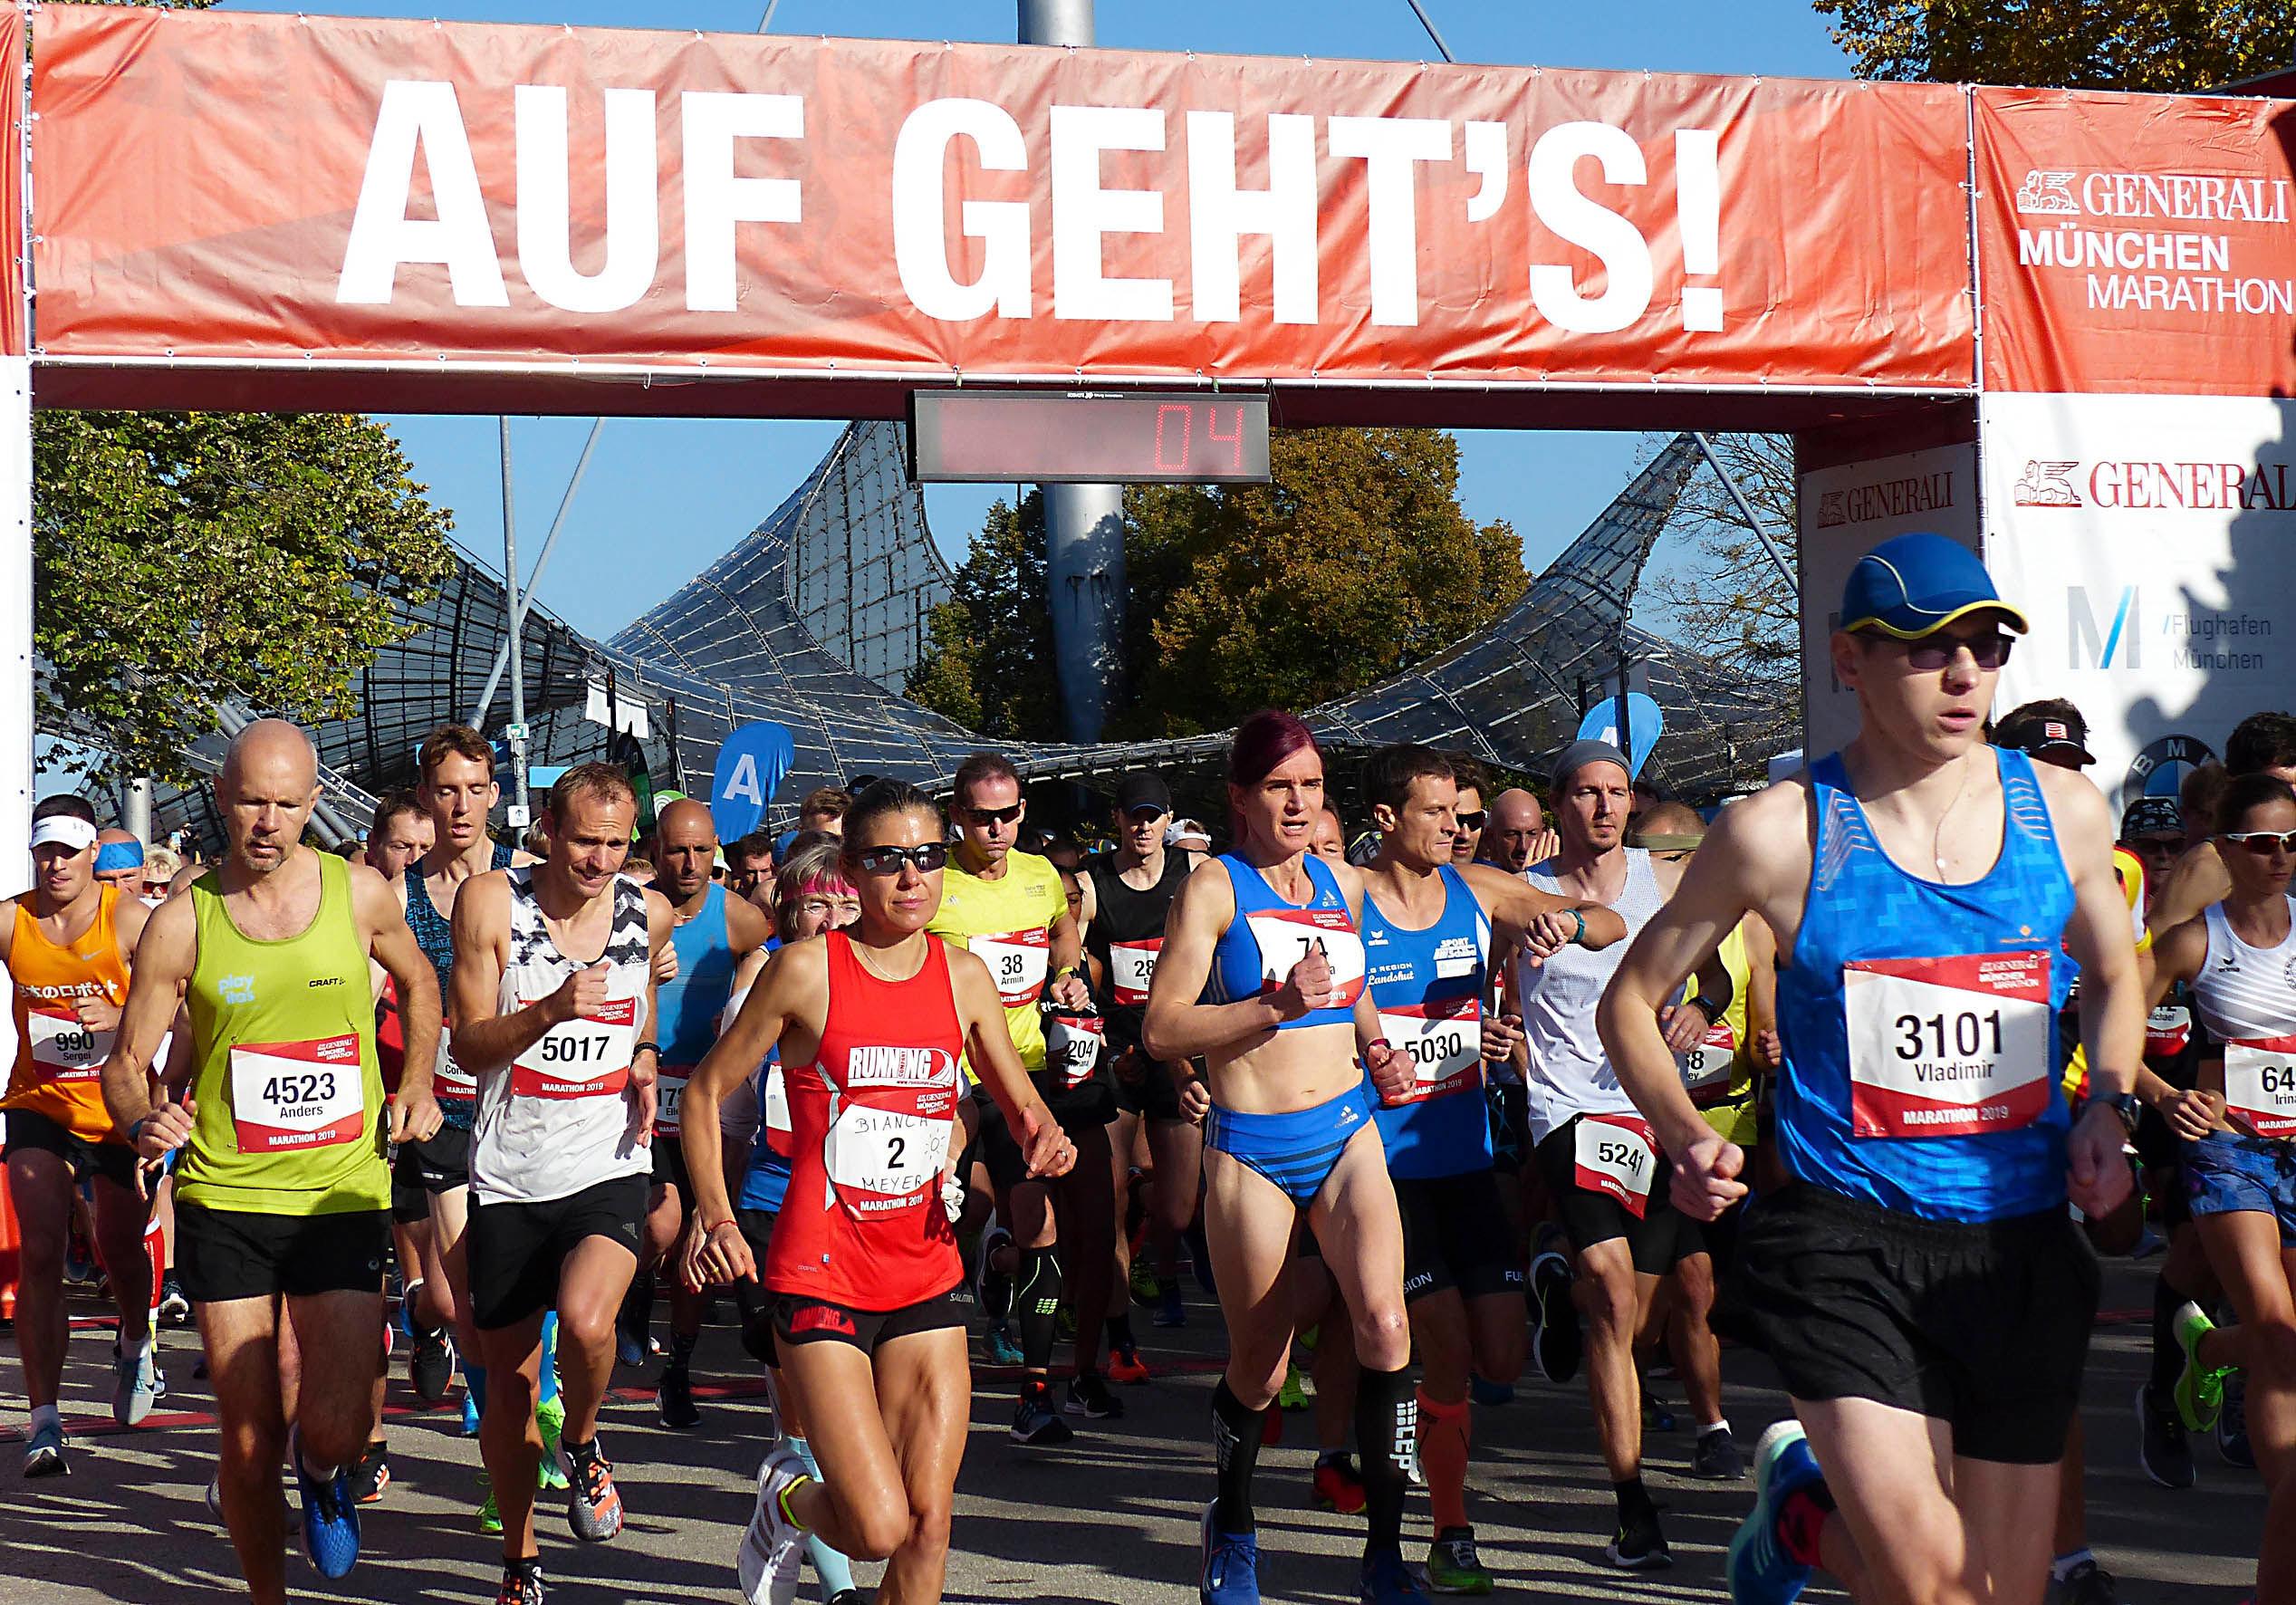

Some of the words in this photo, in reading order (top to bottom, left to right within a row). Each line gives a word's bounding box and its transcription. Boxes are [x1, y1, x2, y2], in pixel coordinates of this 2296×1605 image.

[335, 80, 804, 313] AUF
[892, 97, 1724, 334] GEHT'S!
[2083, 172, 2291, 224] GENERALI
[2019, 222, 2230, 272] MÜNCHEN
[2086, 274, 2293, 315] MARATHON
[1847, 471, 1955, 524] GENERALI
[2174, 649, 2263, 670] München
[722, 753, 763, 806] A
[1440, 937, 1469, 948] SPORT
[1001, 954, 1023, 975] 38
[1379, 962, 1413, 973] REGION
[309, 977, 339, 987] CRAFT
[1001, 975, 1024, 985] Armin
[1367, 971, 1414, 986] Landshut
[1978, 971, 2026, 984] MÜNCHEN
[1993, 978, 2040, 990] MARATHON
[1330, 991, 1347, 1001] 2019
[55, 1032, 95, 1052] 990
[1895, 1009, 2003, 1061] 3101
[63, 1052, 91, 1062] Sergei
[542, 1035, 610, 1062] 5017
[1068, 1040, 1094, 1059] 204
[1404, 1033, 1462, 1065] 5030
[56, 1070, 89, 1078] MARATHON
[1915, 1060, 1995, 1082] Vladimir
[2262, 1057, 2296, 1092] 64
[263, 1072, 336, 1105] 4523
[541, 1082, 586, 1093] MARATHON
[587, 1081, 604, 1092] 2019
[1447, 1079, 1463, 1088] 2019
[280, 1105, 323, 1119] Anders
[1903, 1107, 1978, 1125] MARATHON
[1980, 1105, 2009, 1121] 2019
[855, 1113, 928, 1134] BIANCA
[268, 1133, 316, 1146] MARATHON
[318, 1129, 336, 1141] 2019
[888, 1137, 906, 1169] 2
[1599, 1142, 1645, 1177] 5241
[861, 1174, 922, 1194] MEYER
[860, 1197, 907, 1212] MARATHON
[908, 1194, 924, 1206] 2019
[1389, 1425, 1417, 1471] cep
